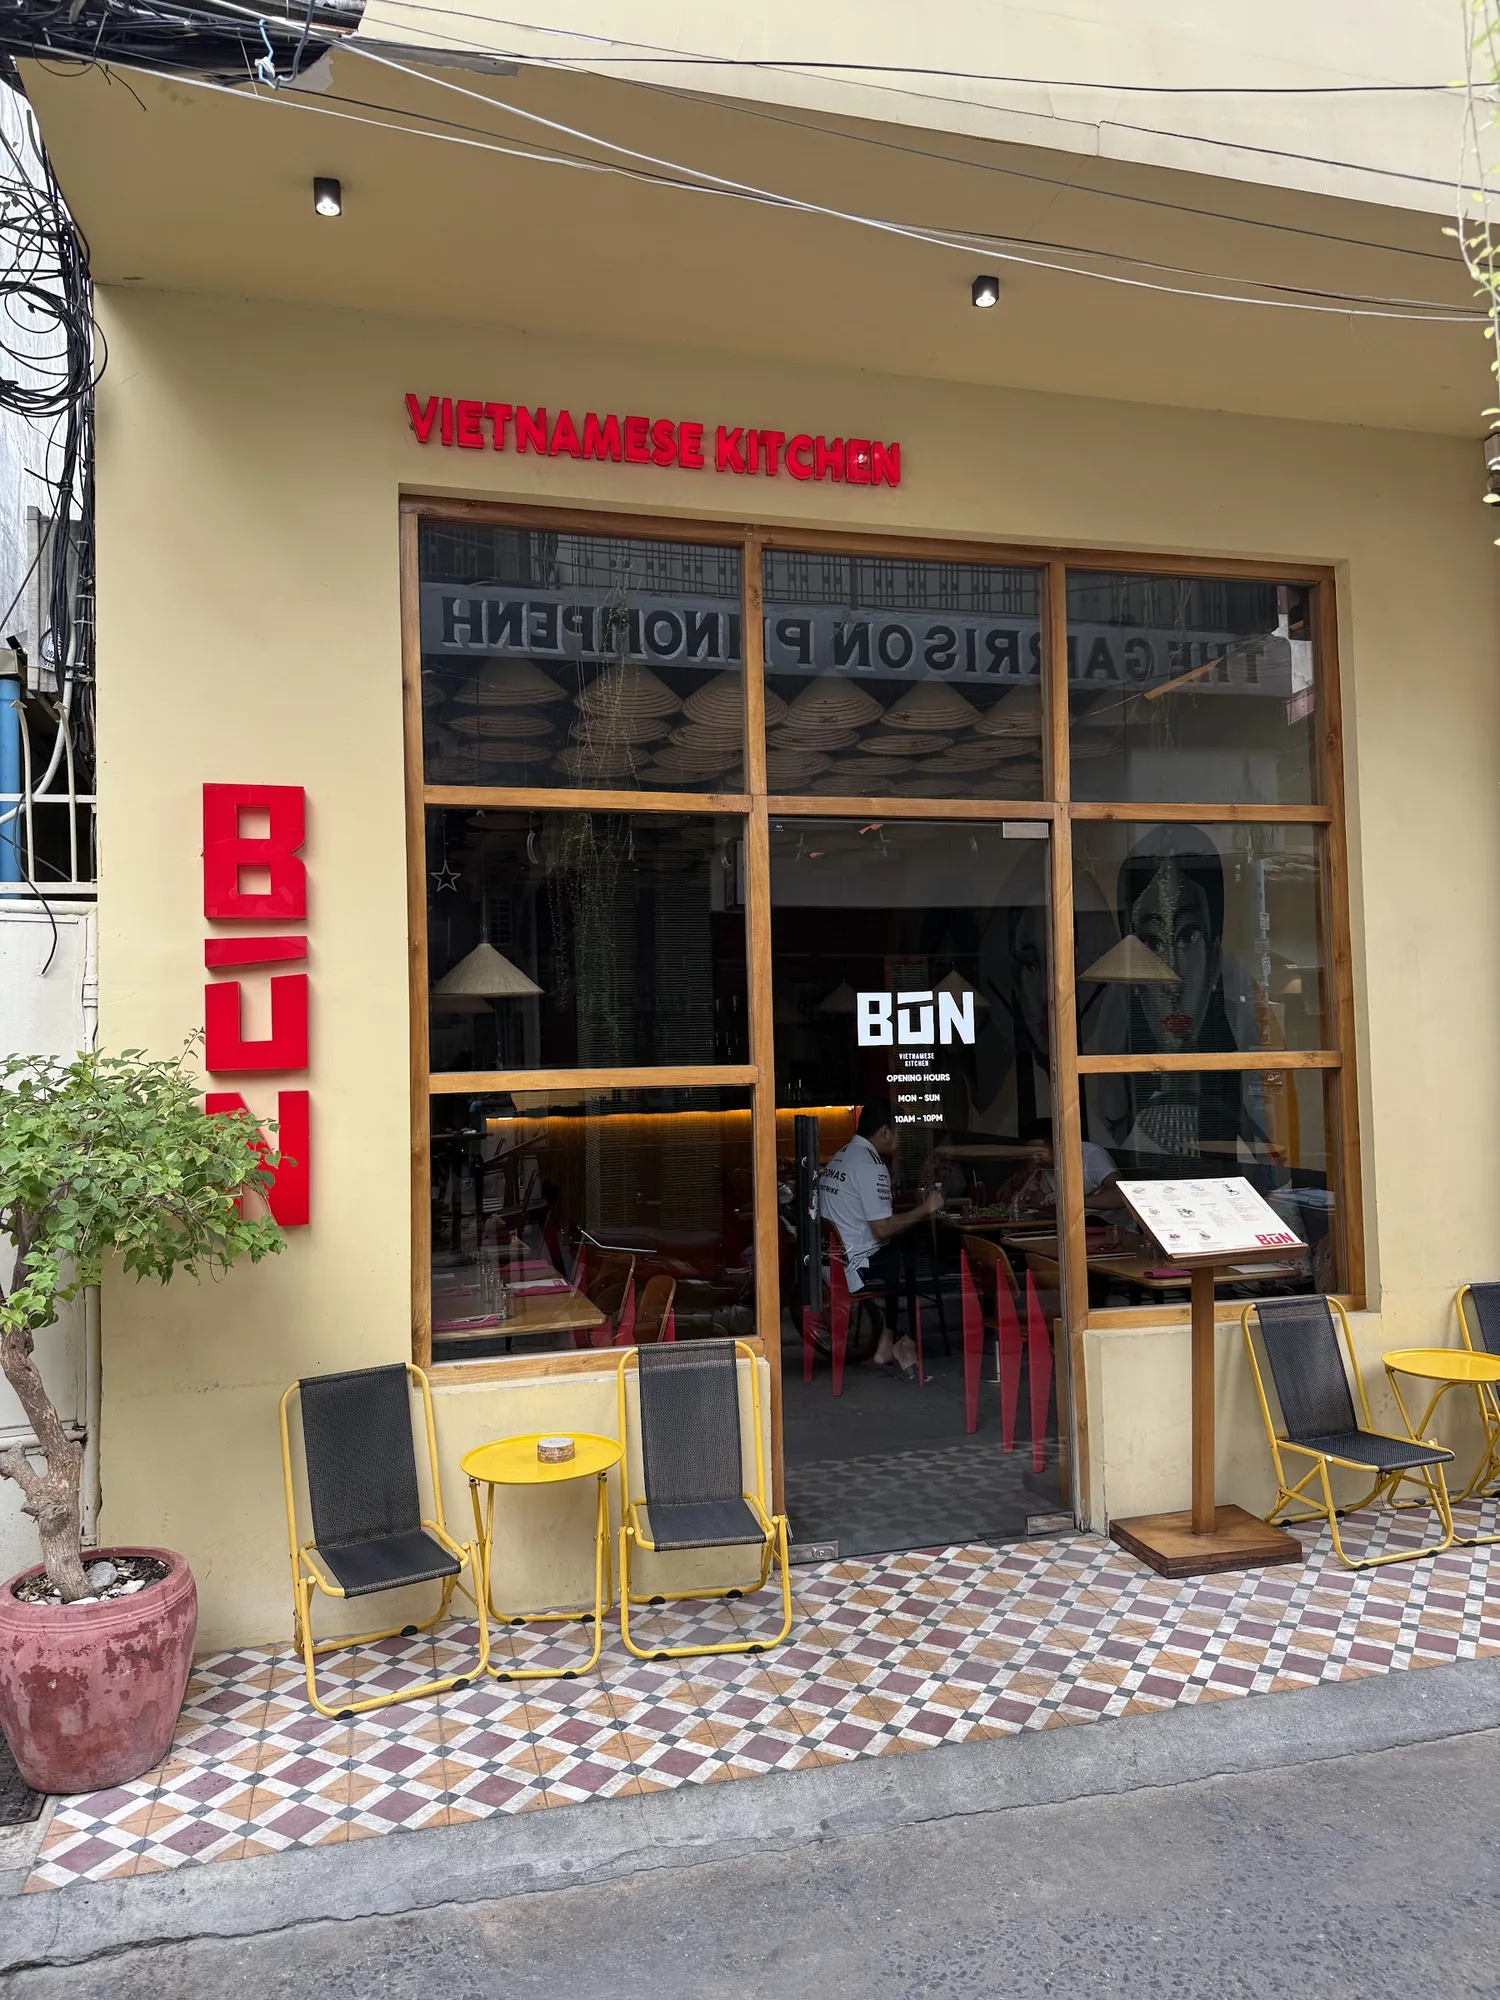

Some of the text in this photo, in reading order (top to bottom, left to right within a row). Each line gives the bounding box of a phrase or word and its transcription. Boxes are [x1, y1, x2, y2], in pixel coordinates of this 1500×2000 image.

[405, 393, 901, 487] VIETNAMESE KITCHEN
[886, 1073, 951, 1083] OPENING HOURS
[897, 1094, 917, 1102] MON
[924, 1093, 940, 1102] SUN
[895, 1115, 916, 1123] 10AM
[923, 1114, 943, 1122] 10PM
